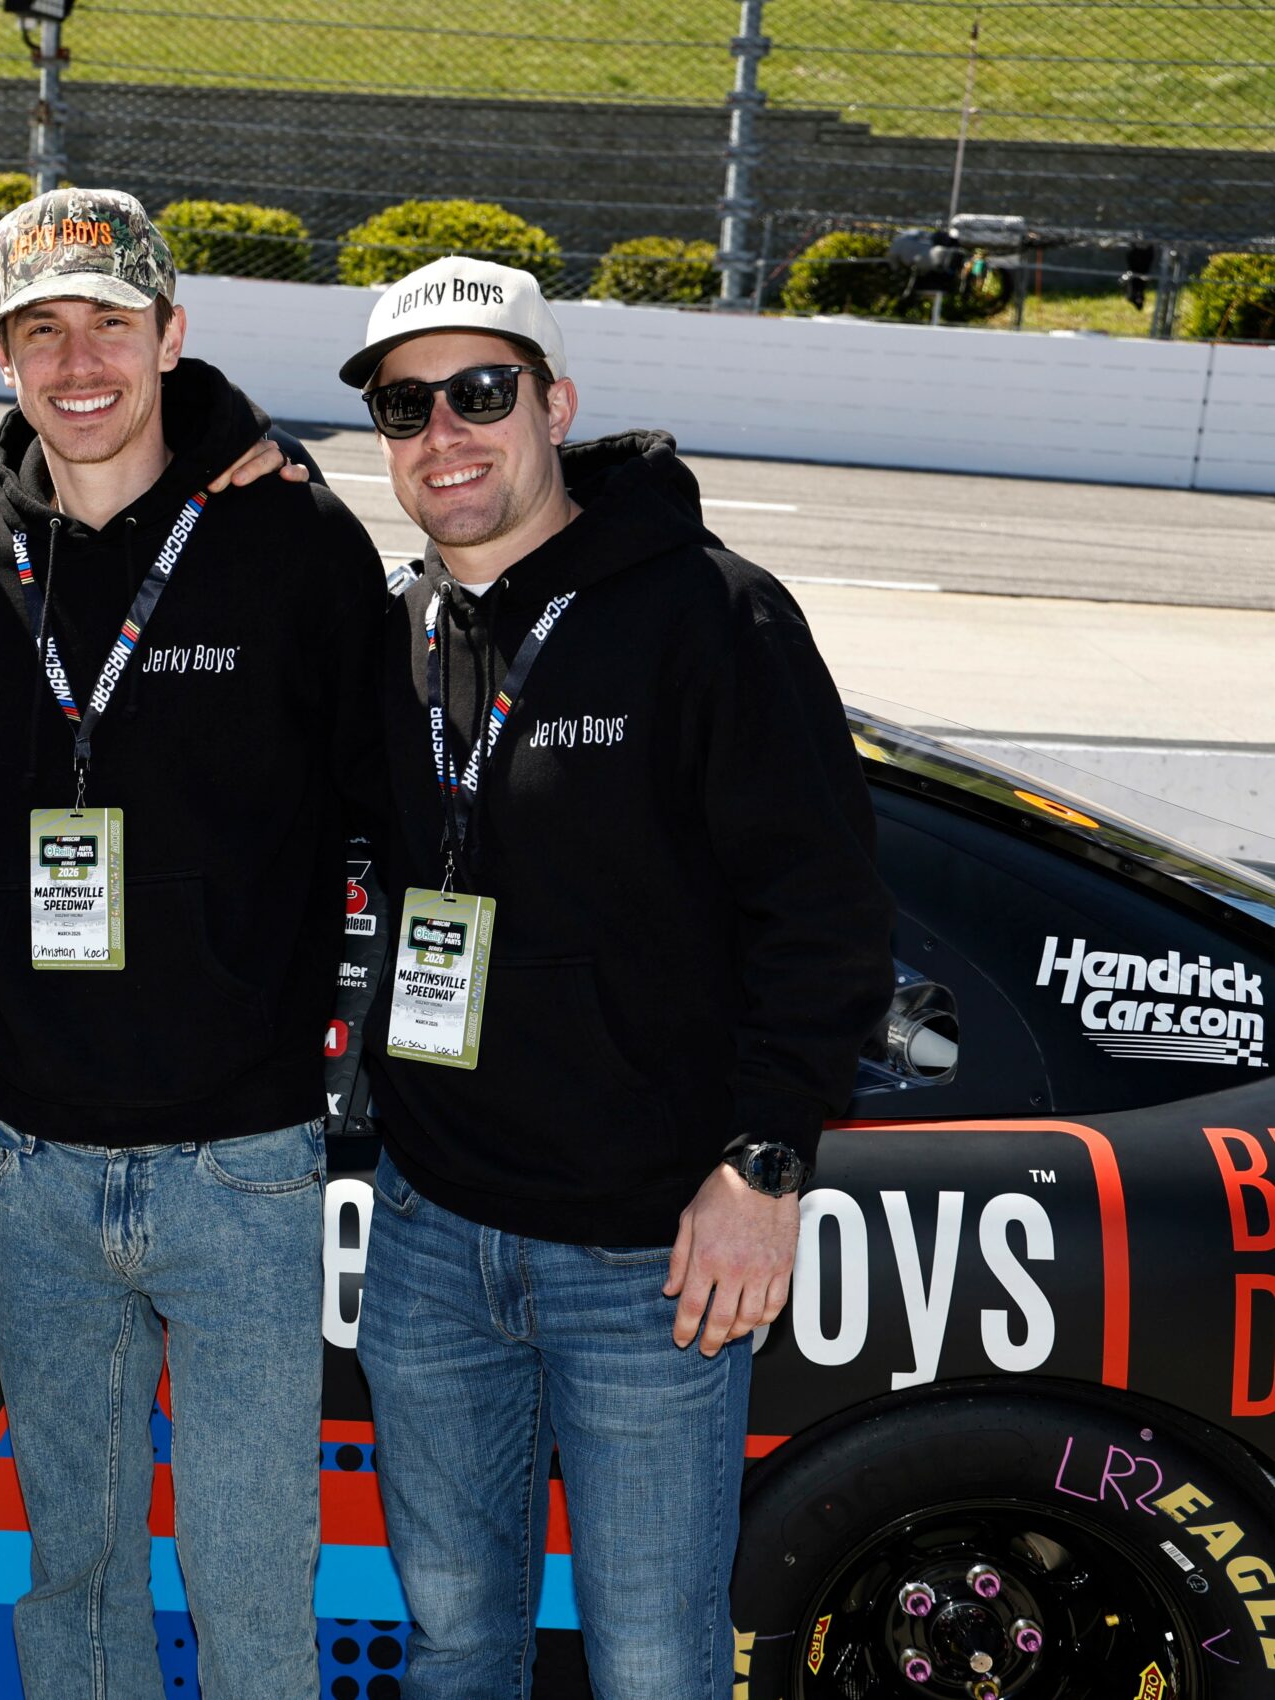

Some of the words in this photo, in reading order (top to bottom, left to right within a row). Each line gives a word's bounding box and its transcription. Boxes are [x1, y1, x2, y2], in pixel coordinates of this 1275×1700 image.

[9, 224, 56, 263] Jerky
[62, 218, 113, 248] Boys
[392, 282, 446, 319] Jerky
[453, 277, 504, 305] Boys
[13, 530, 29, 564] NAS
[155, 503, 200, 575] NASCAR
[531, 591, 576, 642] SCAR
[143, 646, 190, 673] Jerky
[193, 645, 235, 673] Boys
[90, 641, 131, 713] NASCAR
[530, 718, 577, 748] Jerky
[583, 715, 624, 747] Boys
[44, 843, 77, 859] O'Reilly
[58, 868, 79, 878] 2026
[34, 886, 104, 898] MARTINSVILLE
[43, 899, 94, 911] SPEEDWAY
[33, 944, 76, 959] Christian
[444, 938, 462, 946] PARTS
[338, 963, 368, 978] iller
[423, 952, 445, 965] 2026
[1036, 936, 1264, 1006] Hendrick
[397, 969, 467, 990] MARTINSVILLE
[405, 984, 456, 1002] SPEEDWAY
[1081, 989, 1264, 1041] Cars.com
[792, 1188, 1056, 1391] oys
[1055, 1436, 1163, 1516] LR2
[809, 1622, 823, 1663] AERO
[1143, 1673, 1160, 1700] ERO
